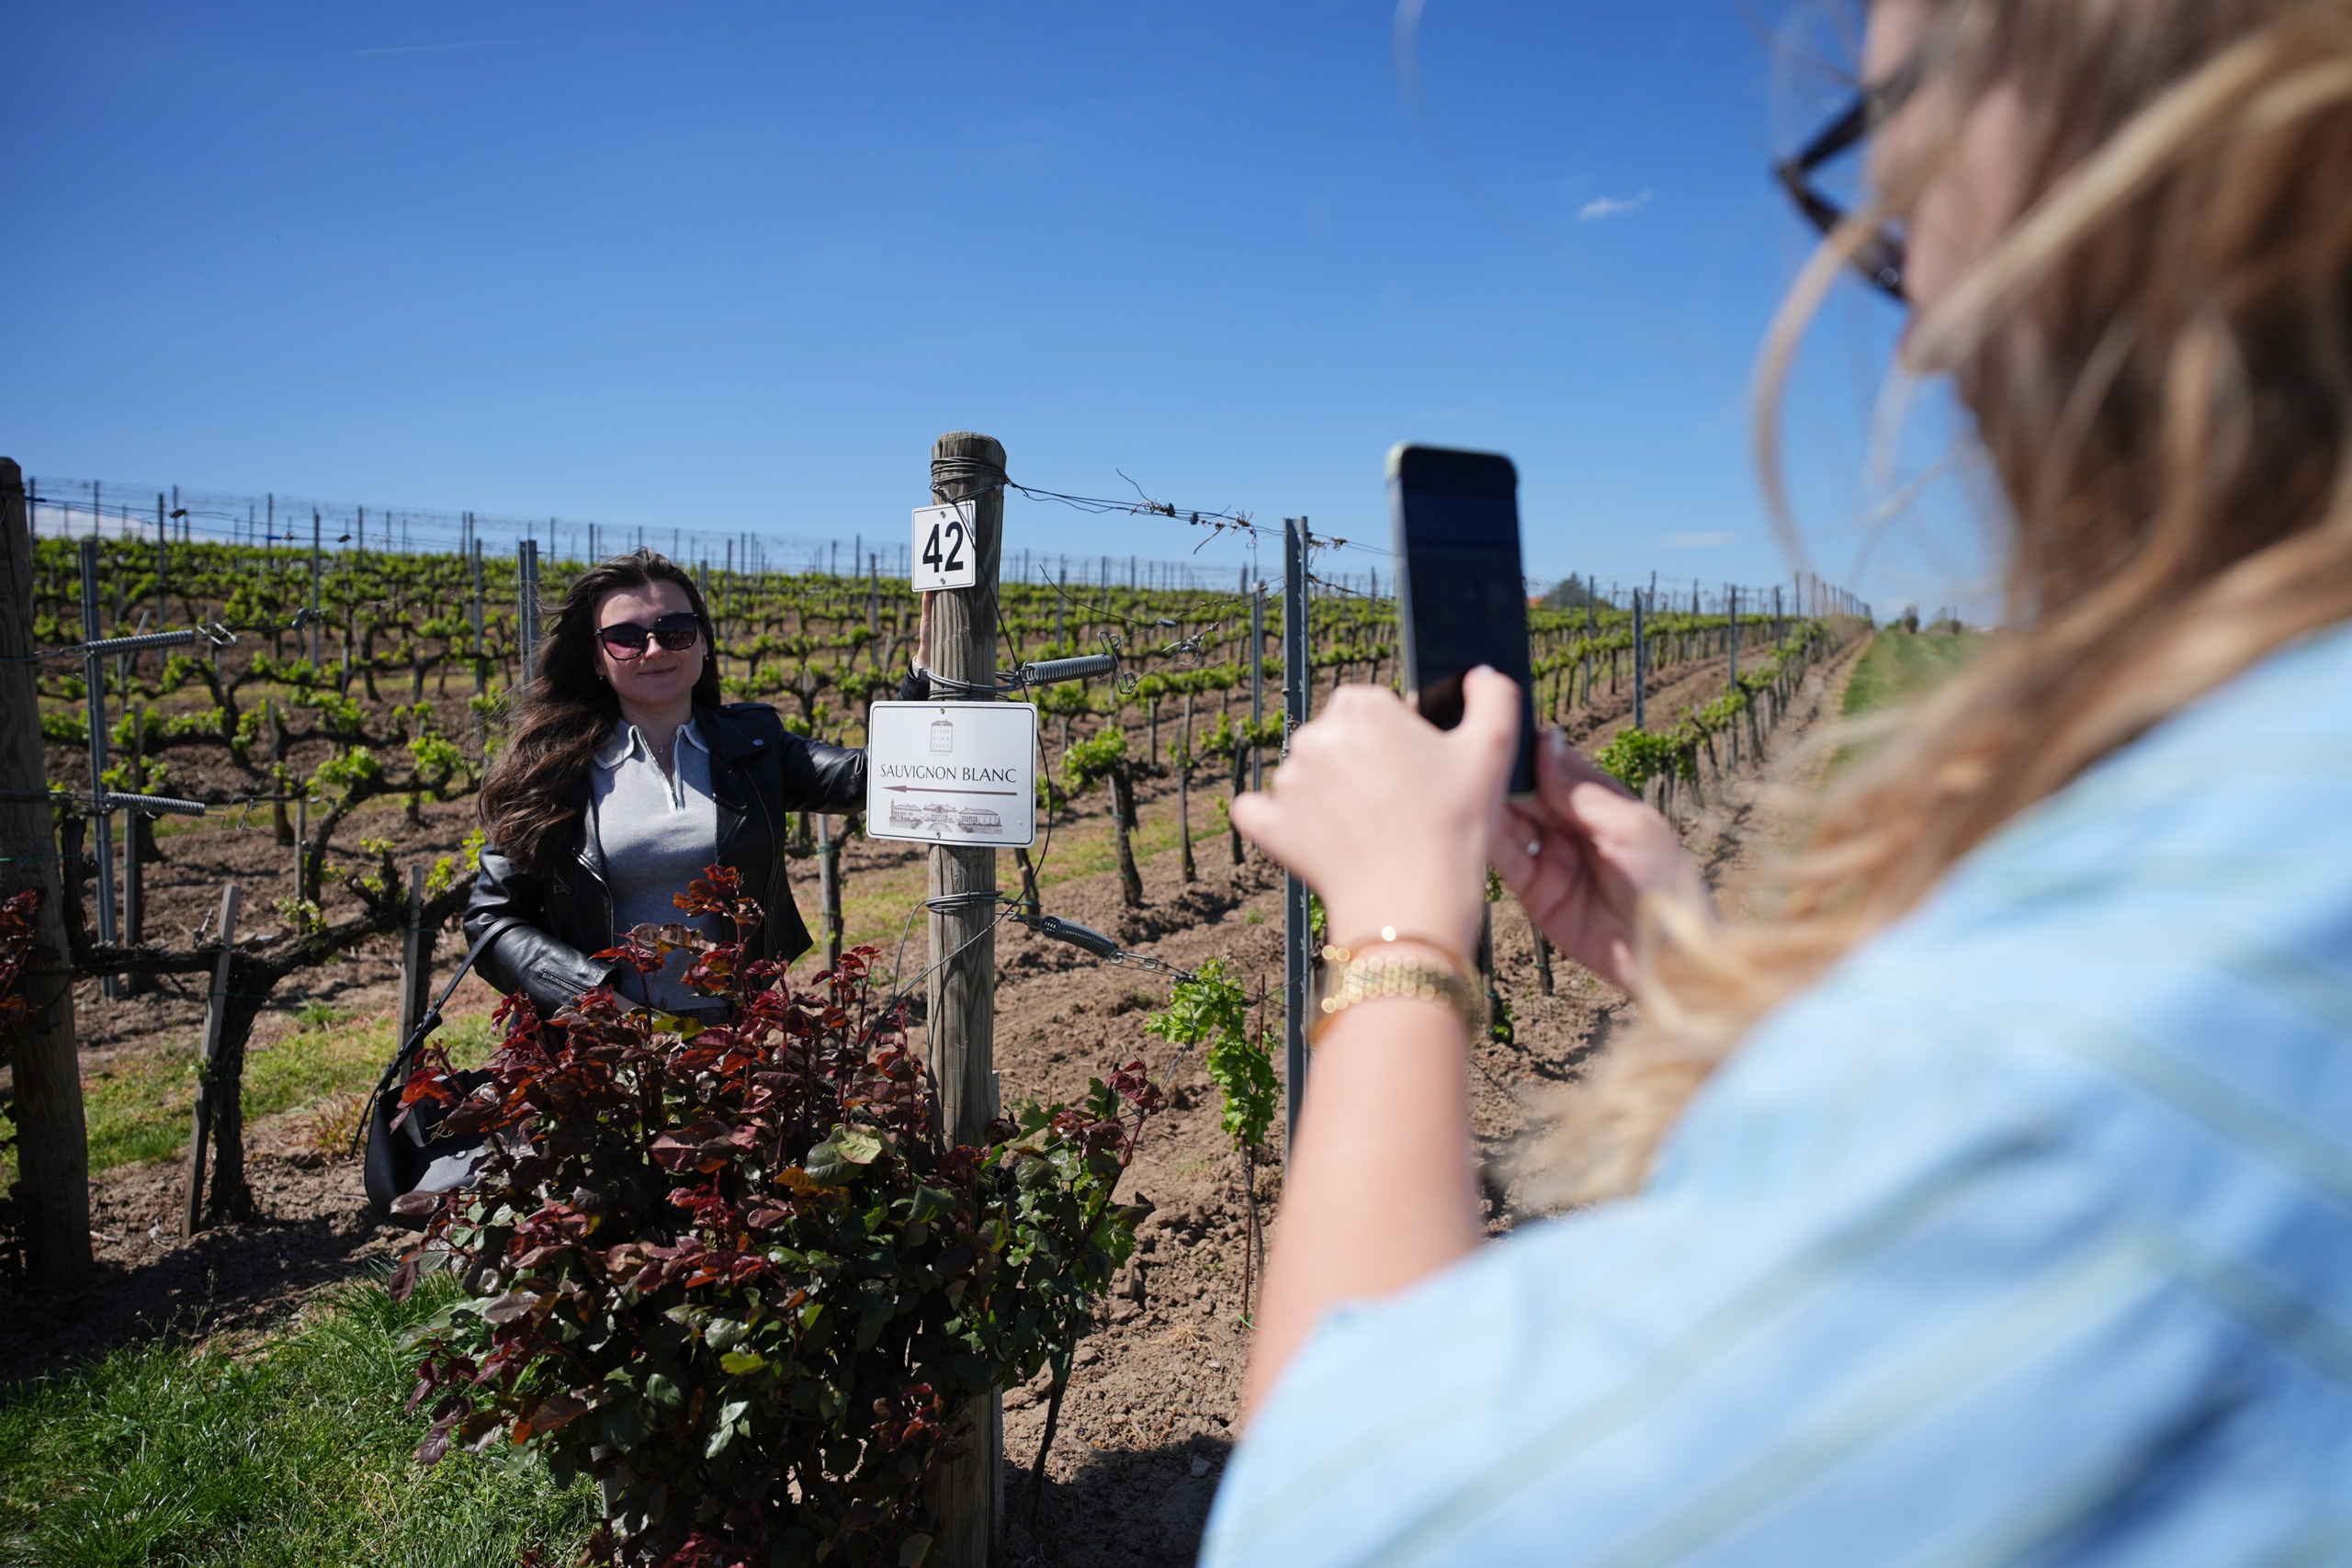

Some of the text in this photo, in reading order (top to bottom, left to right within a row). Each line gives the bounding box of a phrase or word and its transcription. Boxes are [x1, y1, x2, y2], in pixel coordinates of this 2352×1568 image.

[922, 521, 964, 573] 42
[880, 764, 1017, 783] SAUVIGNON BLANC
